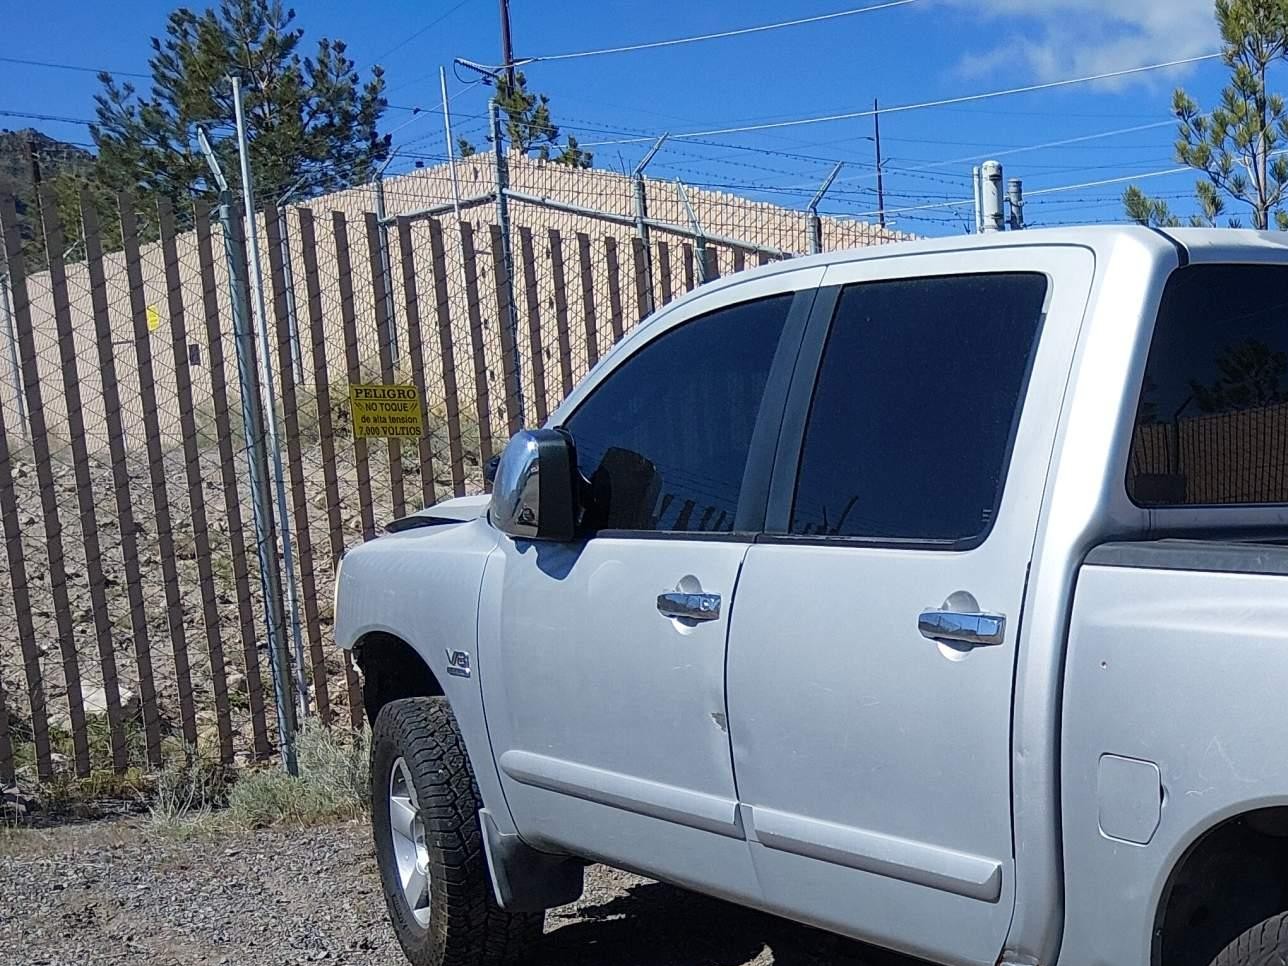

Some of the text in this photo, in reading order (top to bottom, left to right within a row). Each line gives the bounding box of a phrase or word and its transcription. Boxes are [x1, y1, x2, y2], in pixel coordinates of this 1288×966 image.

[354, 388, 417, 399] PELIGRO
[365, 402, 409, 412] NO TOQUE
[361, 415, 371, 423] de
[373, 415, 388, 423] alta
[381, 426, 422, 436] VOLTIOS
[445, 647, 470, 669] V8
